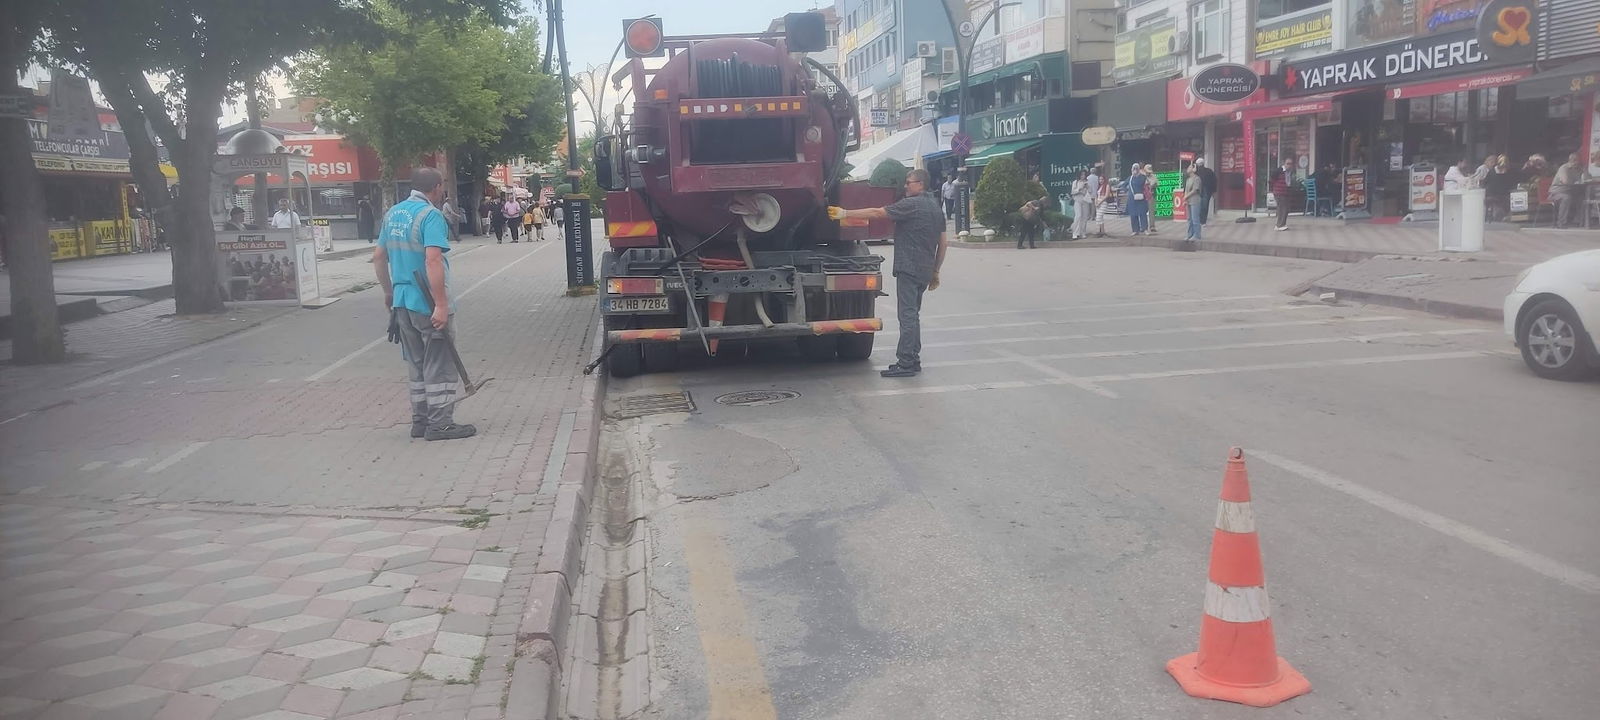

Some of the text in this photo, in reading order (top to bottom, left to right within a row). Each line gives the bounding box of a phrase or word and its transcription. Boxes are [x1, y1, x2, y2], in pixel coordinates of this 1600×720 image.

[1301, 38, 1489, 89] YAPRAK DÖNERC
[1208, 77, 1244, 85] YAPRAK
[1199, 83, 1252, 94] DÖNERCİSİ
[994, 112, 1028, 138] linaria
[221, 242, 231, 250] Su
[572, 210, 584, 284] SİNCAN BELEDİYESİ
[611, 300, 623, 310] 34
[626, 299, 638, 310] HB
[642, 298, 667, 309] 7284
